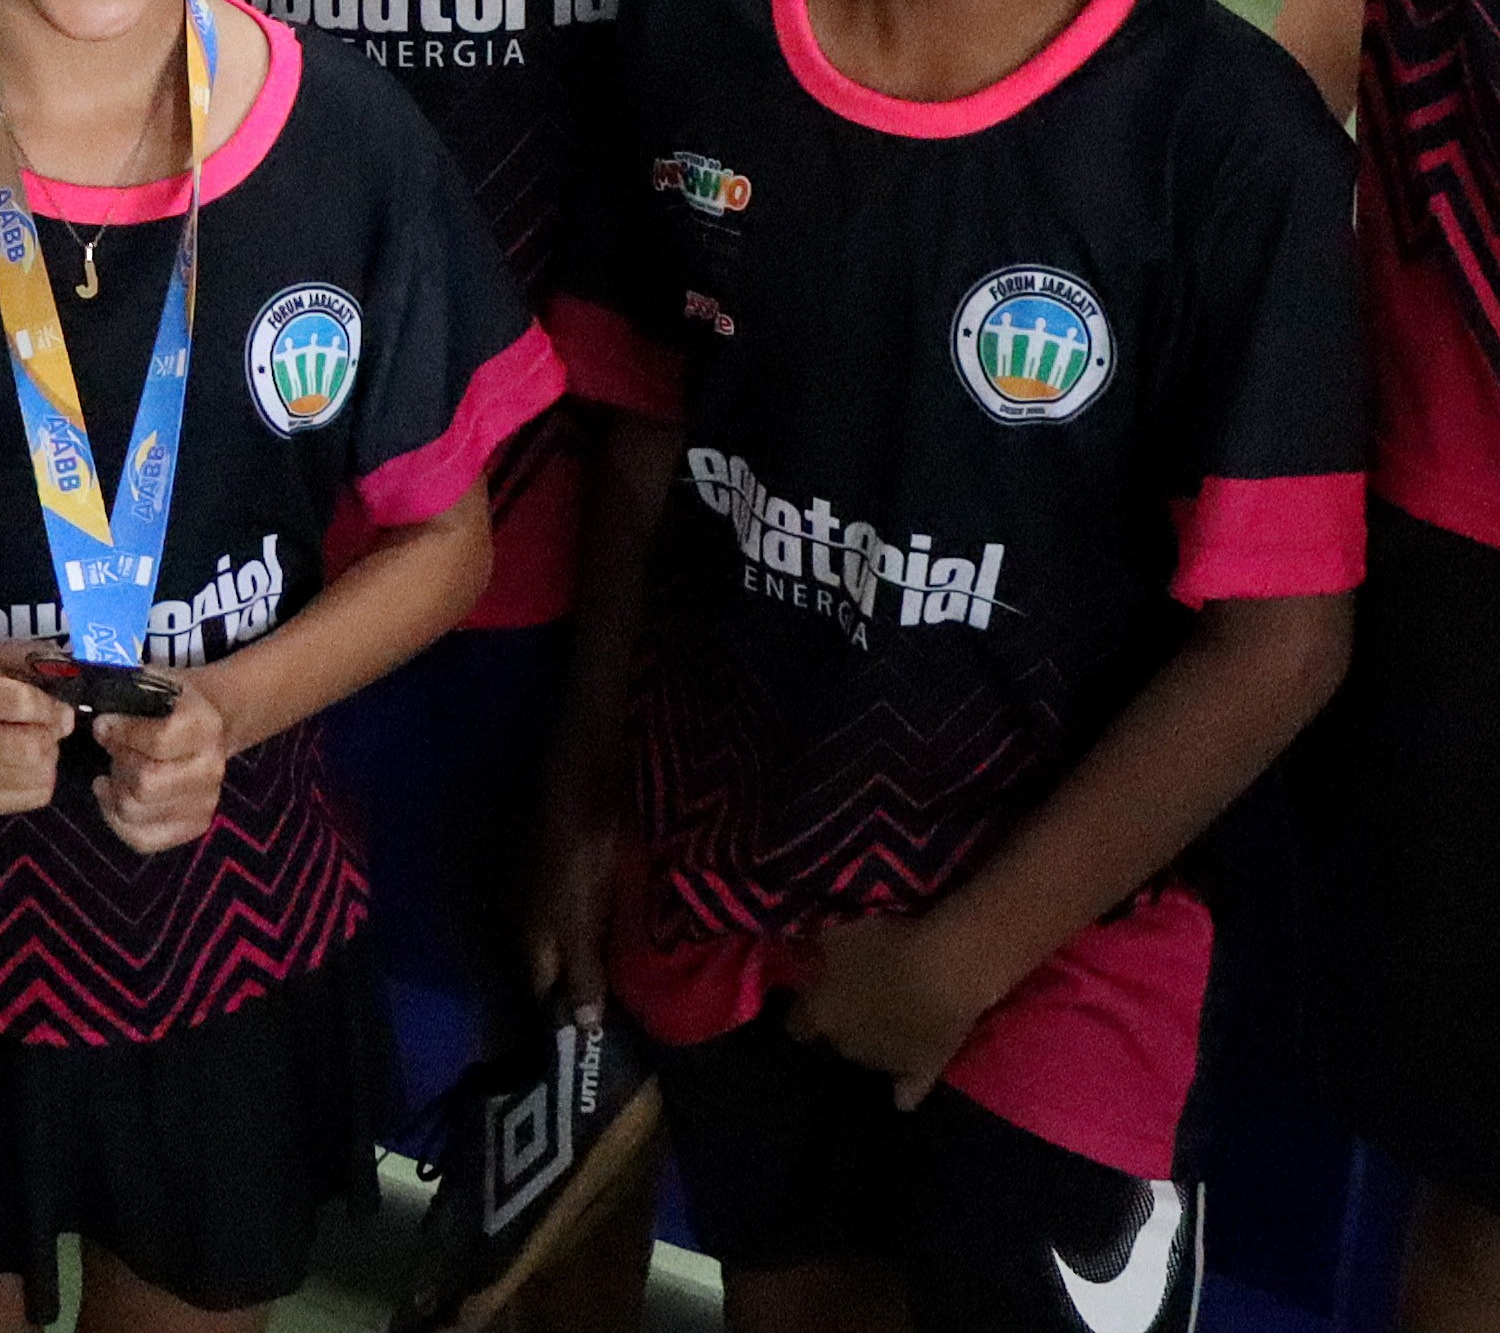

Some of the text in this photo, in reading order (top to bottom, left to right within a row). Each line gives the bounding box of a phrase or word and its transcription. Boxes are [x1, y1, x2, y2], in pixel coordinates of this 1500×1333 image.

[989, 275, 1099, 319] FÓRUM JARACATY
[46, 417, 82, 493] AABB
